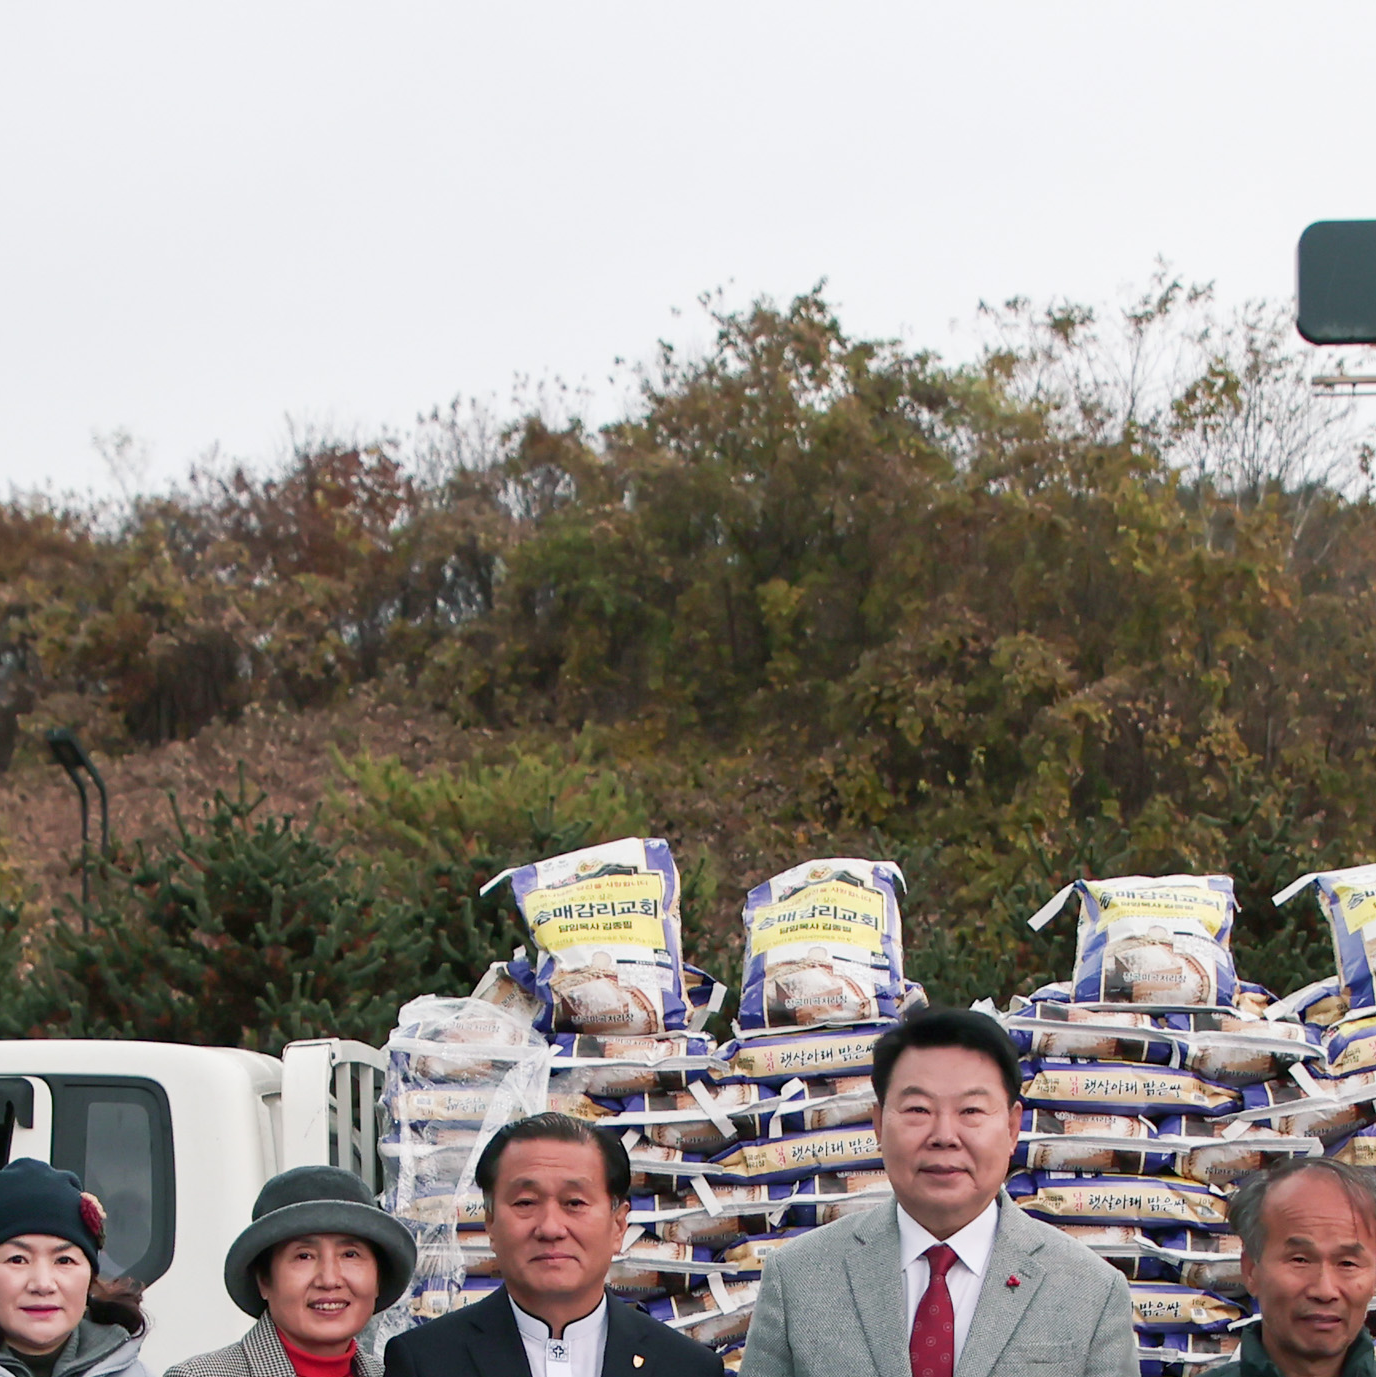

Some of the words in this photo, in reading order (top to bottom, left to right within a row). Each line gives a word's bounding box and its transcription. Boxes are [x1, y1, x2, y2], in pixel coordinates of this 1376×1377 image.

[534, 898, 658, 925] 송매감리교회
[757, 904, 878, 931] 송매감리교회
[780, 1048, 834, 1069] 햇살아래
[1083, 1078, 1138, 1096] 햇살아래
[1142, 1080, 1183, 1098] 맑은쌀
[791, 1142, 845, 1162] 햇살아래
[848, 1137, 880, 1156] 맑은
[1088, 1194, 1143, 1211] 햇살아래
[1147, 1196, 1188, 1214] 맑은쌀
[1139, 1301, 1182, 1319] 맑은쌀
